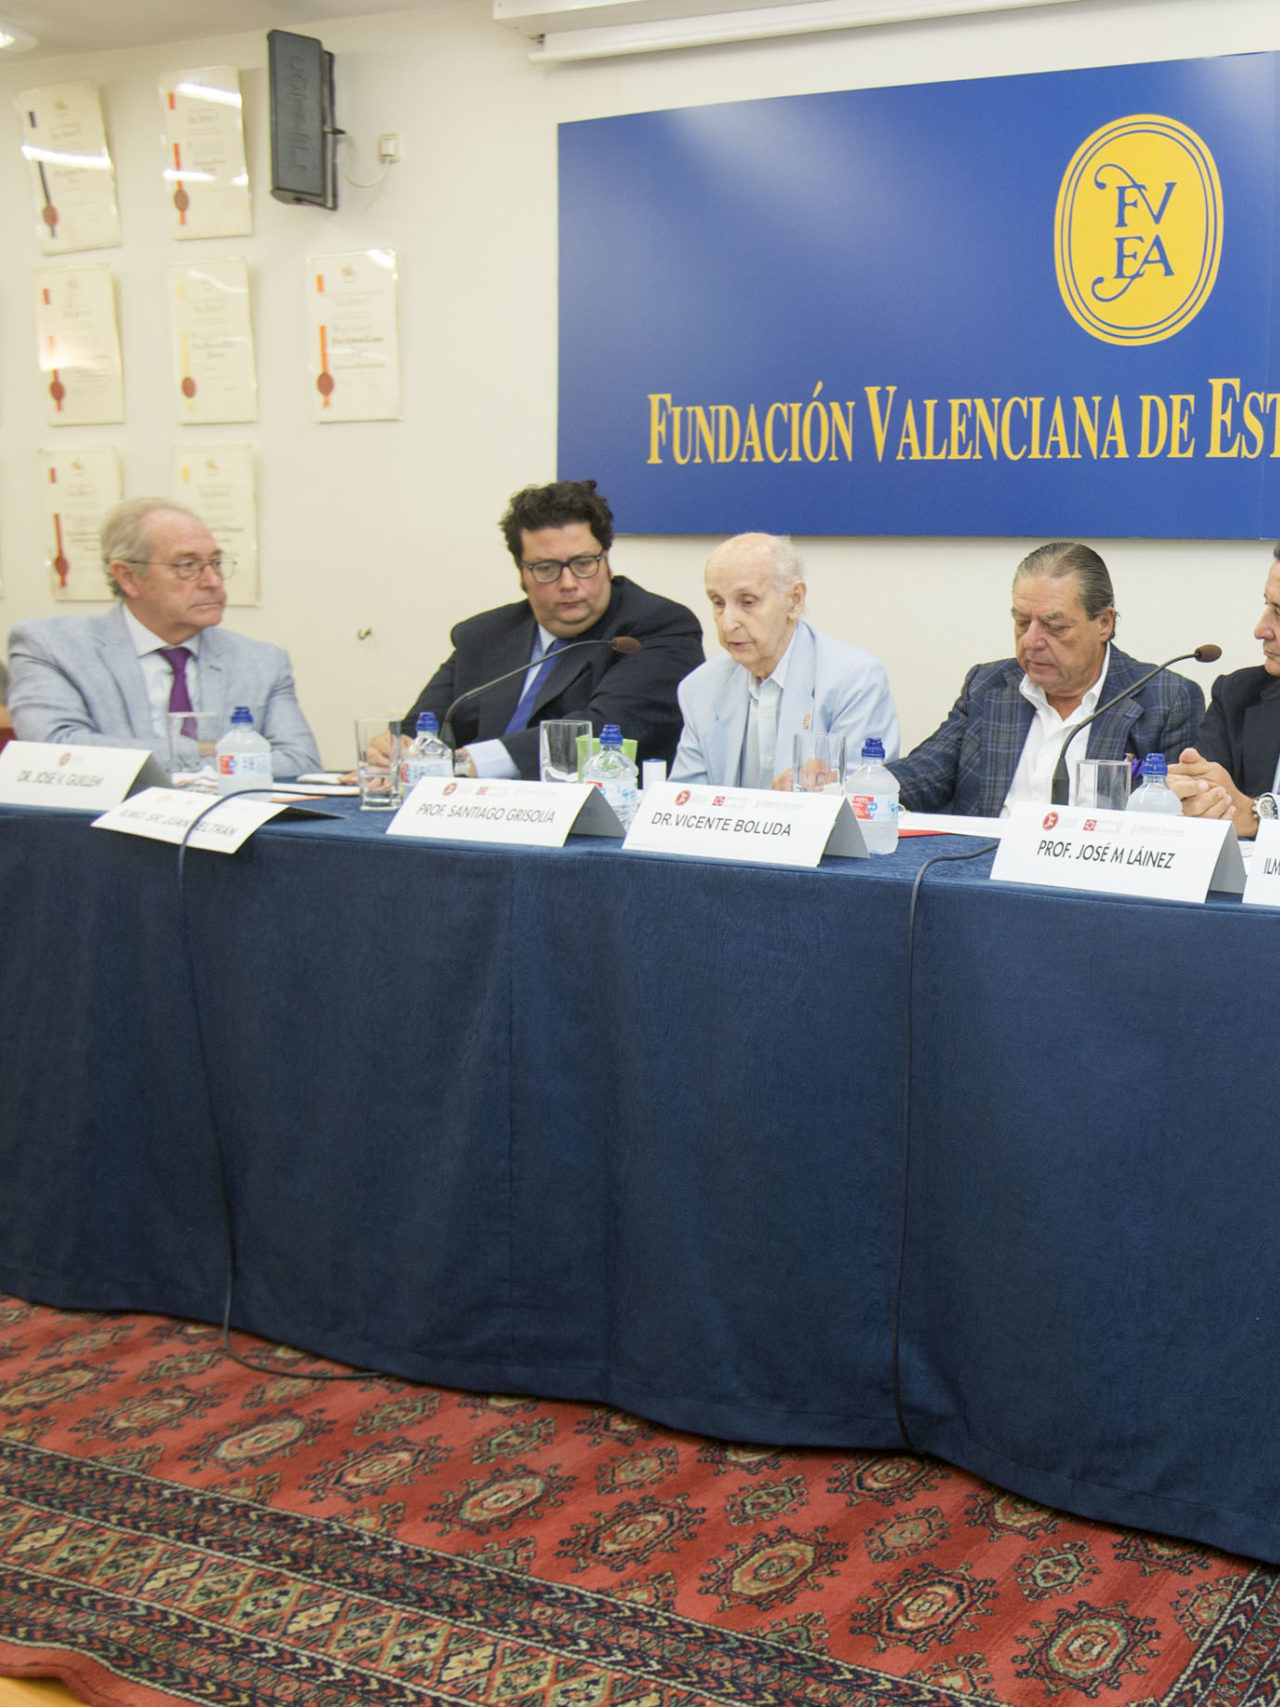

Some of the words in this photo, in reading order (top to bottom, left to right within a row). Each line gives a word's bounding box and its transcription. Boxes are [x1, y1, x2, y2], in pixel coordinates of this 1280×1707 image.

[647, 380, 856, 465] FUNDACIÓN
[864, 385, 1130, 462] VALENCIANA
[1136, 393, 1196, 459] DE
[448, 804, 506, 821] SANTIAGO
[651, 811, 672, 827] DR.
[674, 813, 732, 832] VICENTE
[733, 818, 792, 837] BOLUDA
[1037, 839, 1072, 859] PROF.
[1076, 842, 1110, 863] JOSÉ
[1110, 847, 1125, 864] M
[1126, 845, 1176, 869] LÁINEZ
